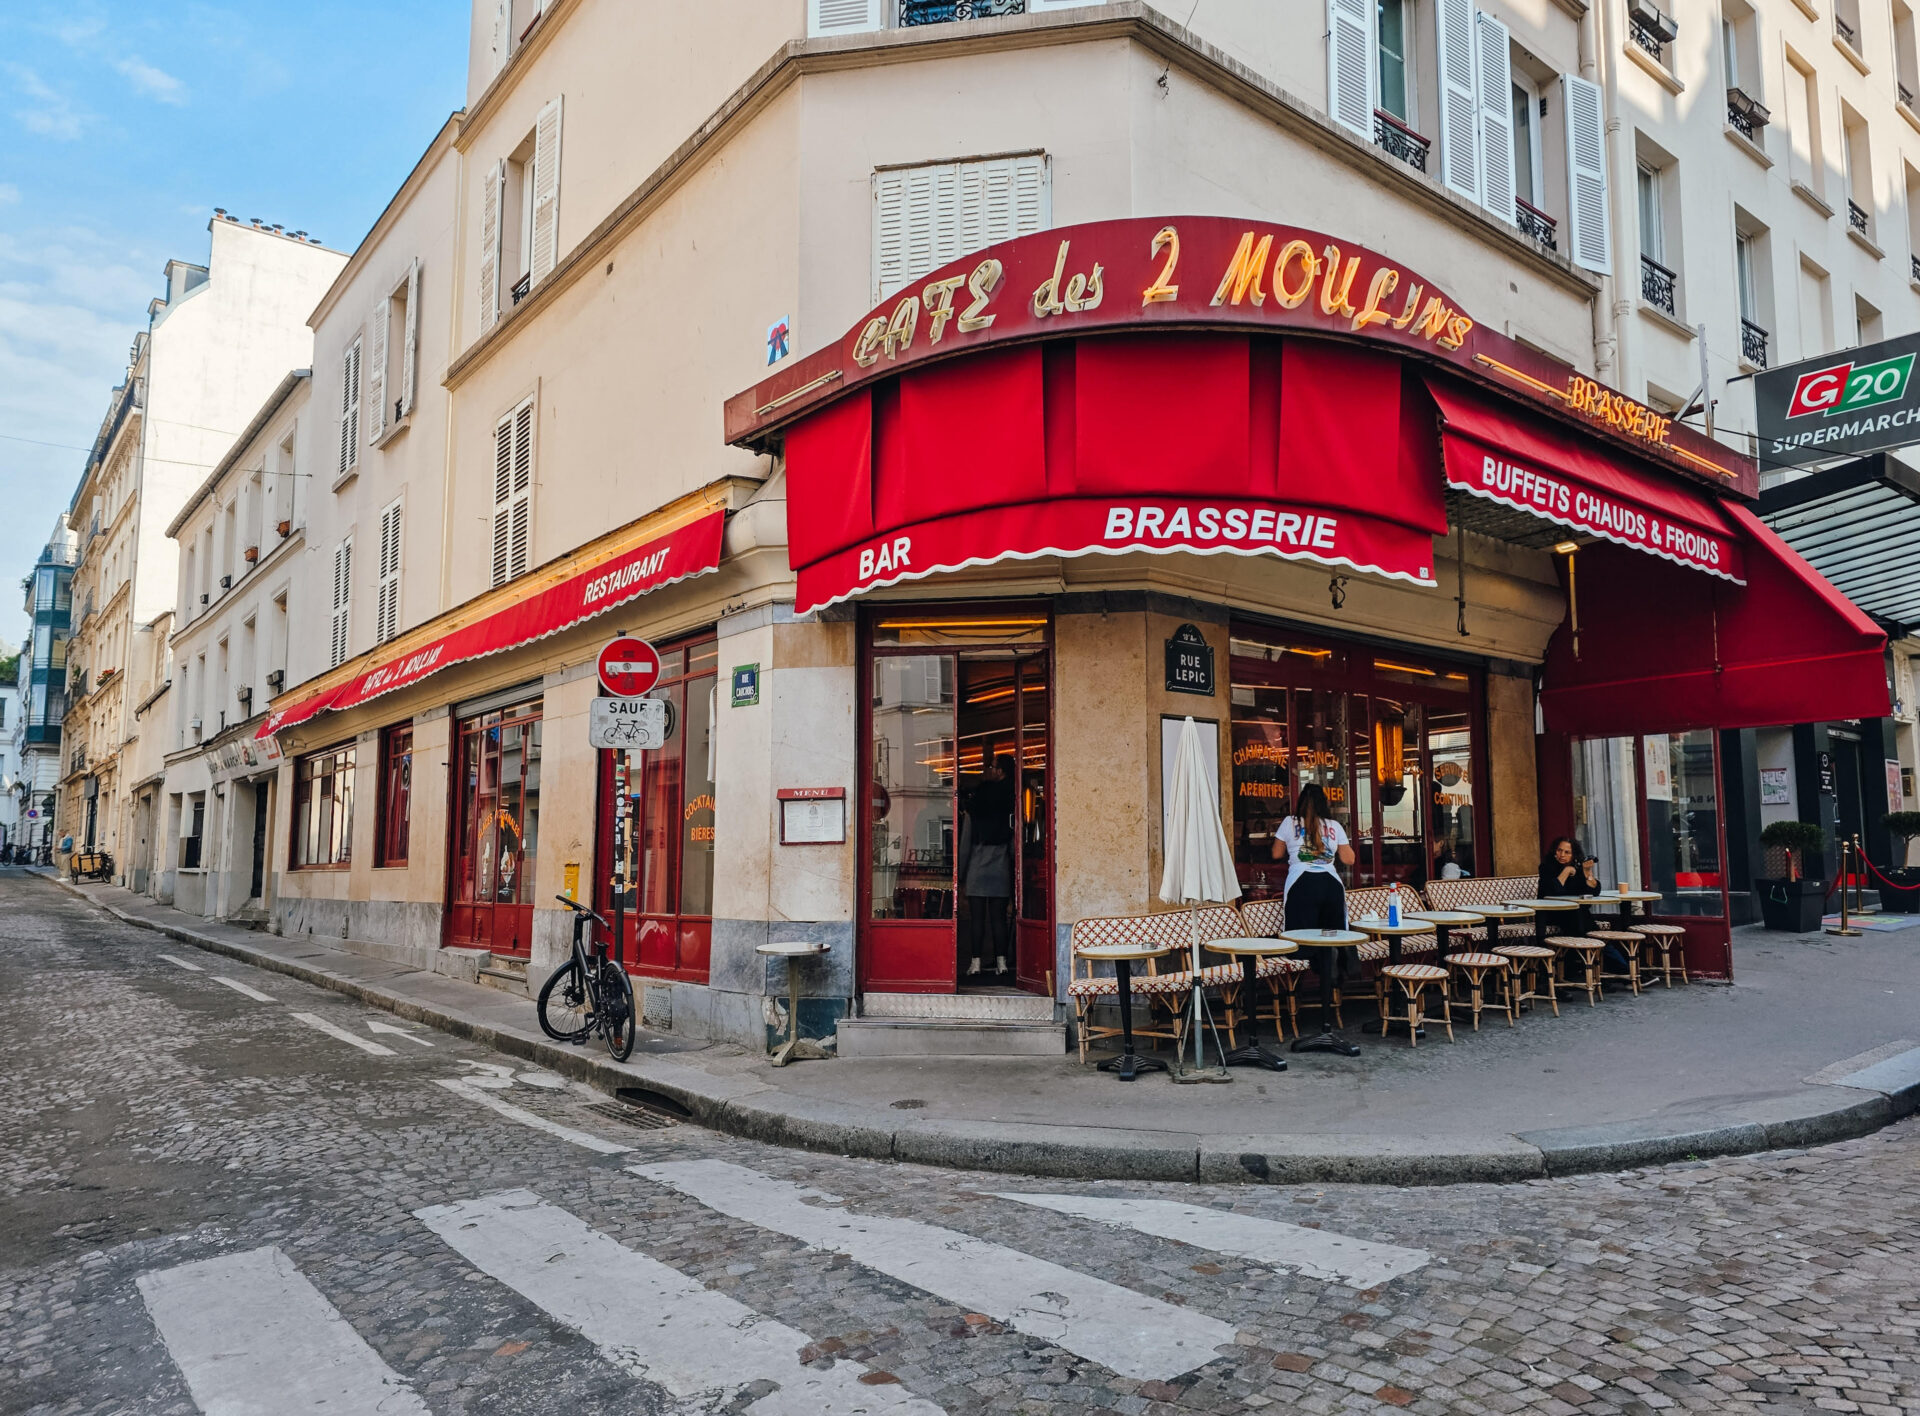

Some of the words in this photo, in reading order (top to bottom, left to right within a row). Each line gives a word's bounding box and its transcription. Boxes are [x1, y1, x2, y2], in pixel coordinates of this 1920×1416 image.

[1032, 240, 1104, 318] des
[1142, 225, 1180, 308] 2
[1209, 231, 1473, 351] MOULINS
[1800, 367, 1901, 407] G20
[1570, 376, 1672, 447] BRASSERIE
[1104, 506, 1338, 549] BRASSERIE
[1482, 456, 1571, 513] BUFFETS
[1575, 491, 1646, 540] CHAUDS
[1651, 519, 1663, 546] &
[1665, 524, 1720, 565] FROIDS
[583, 546, 671, 607] RESTAURANT
[858, 536, 912, 581] BAR
[1175, 668, 1206, 684] LEPIC
[1180, 653, 1201, 668] RUE
[1233, 744, 1289, 770] CHAMPAGNE
[1303, 750, 1340, 771] LUNCH
[793, 789, 829, 797] MENU
[1239, 779, 1285, 799] APÉRITIFS
